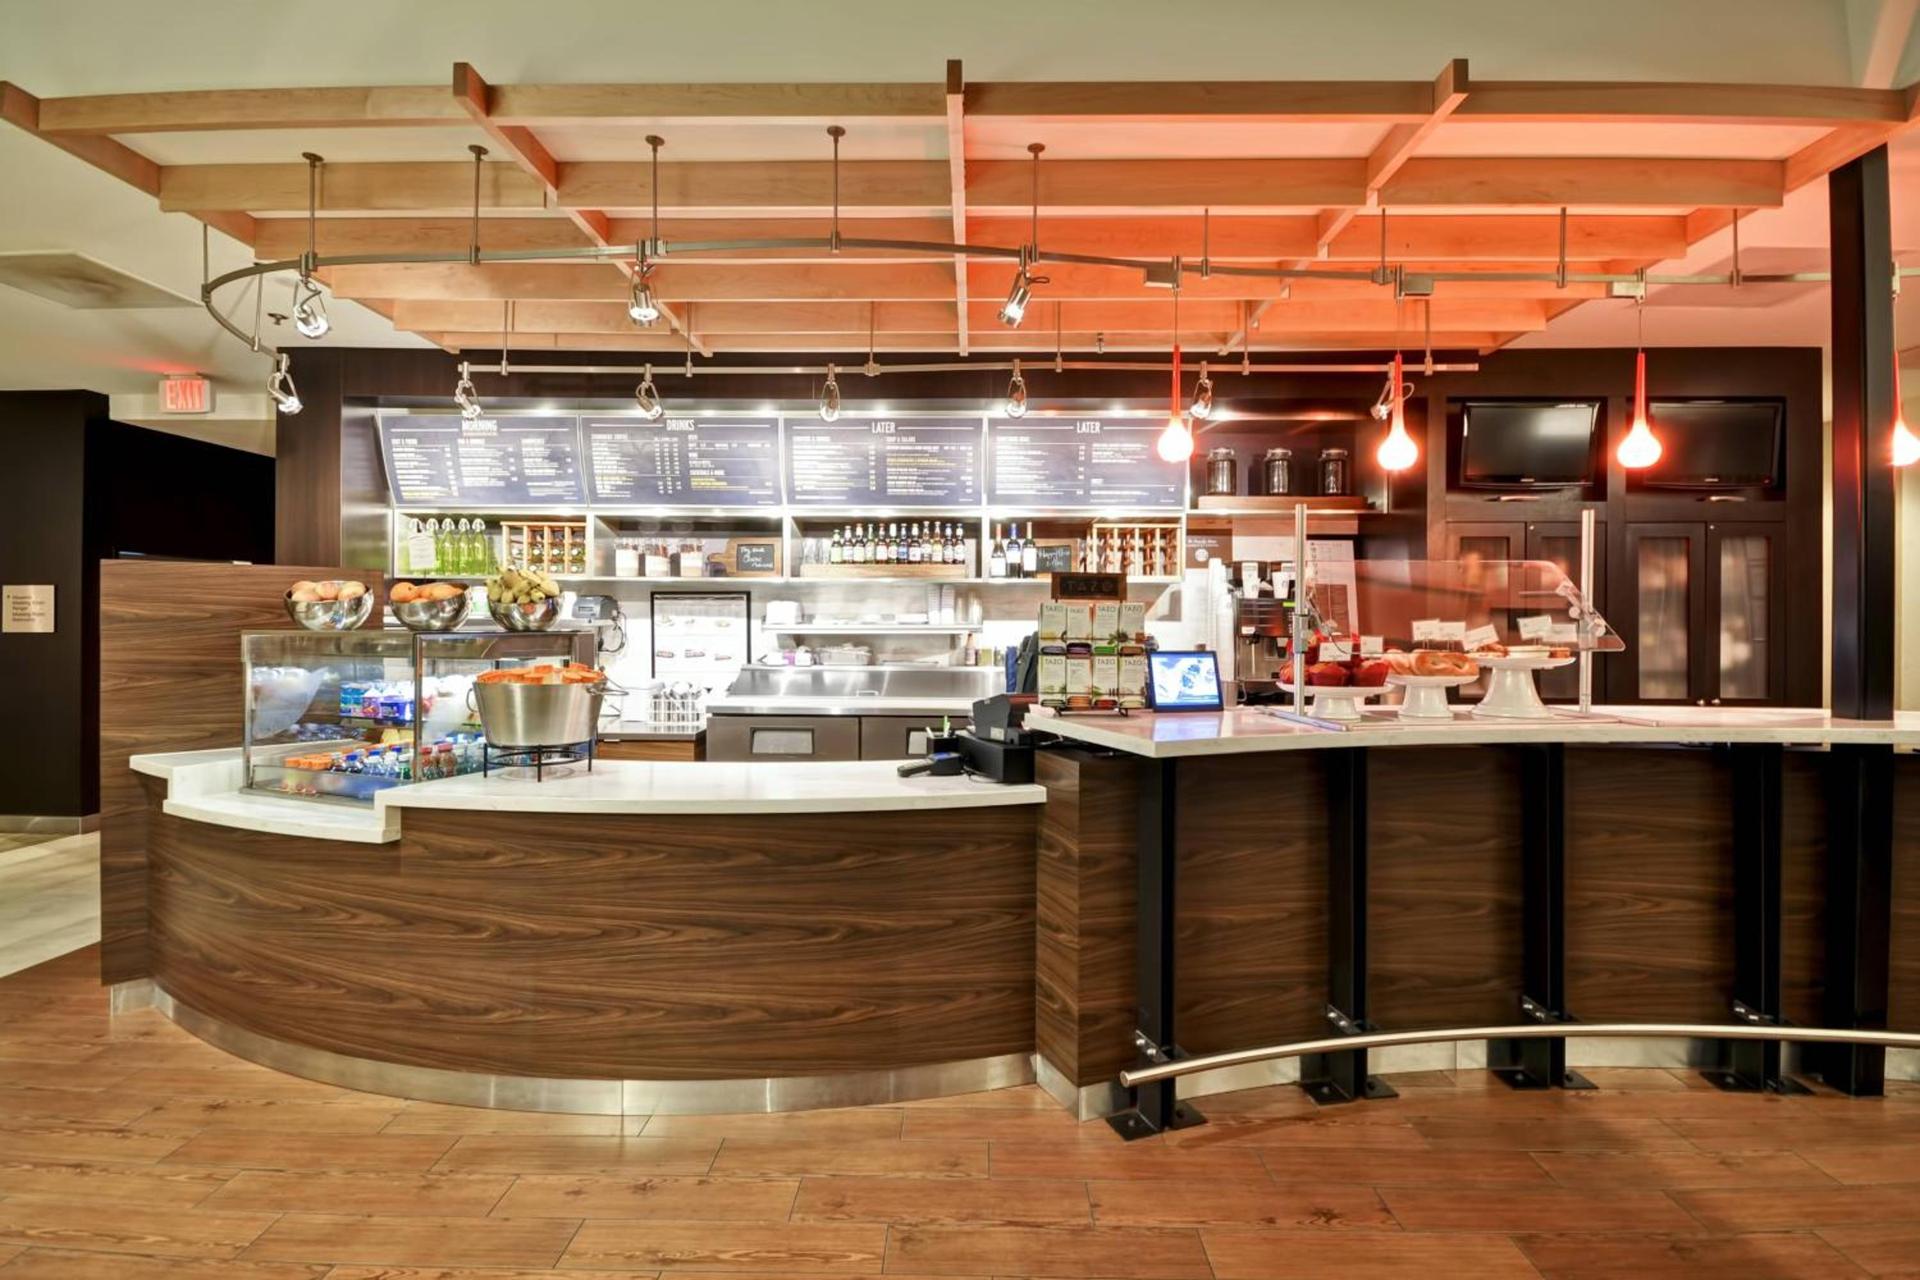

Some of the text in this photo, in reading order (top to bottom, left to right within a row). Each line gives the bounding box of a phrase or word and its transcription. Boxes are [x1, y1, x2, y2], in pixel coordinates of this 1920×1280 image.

[166, 380, 205, 410] EXIT
[666, 419, 695, 431] DRINKS
[871, 421, 896, 433] LATER
[1076, 420, 1101, 433] LATER
